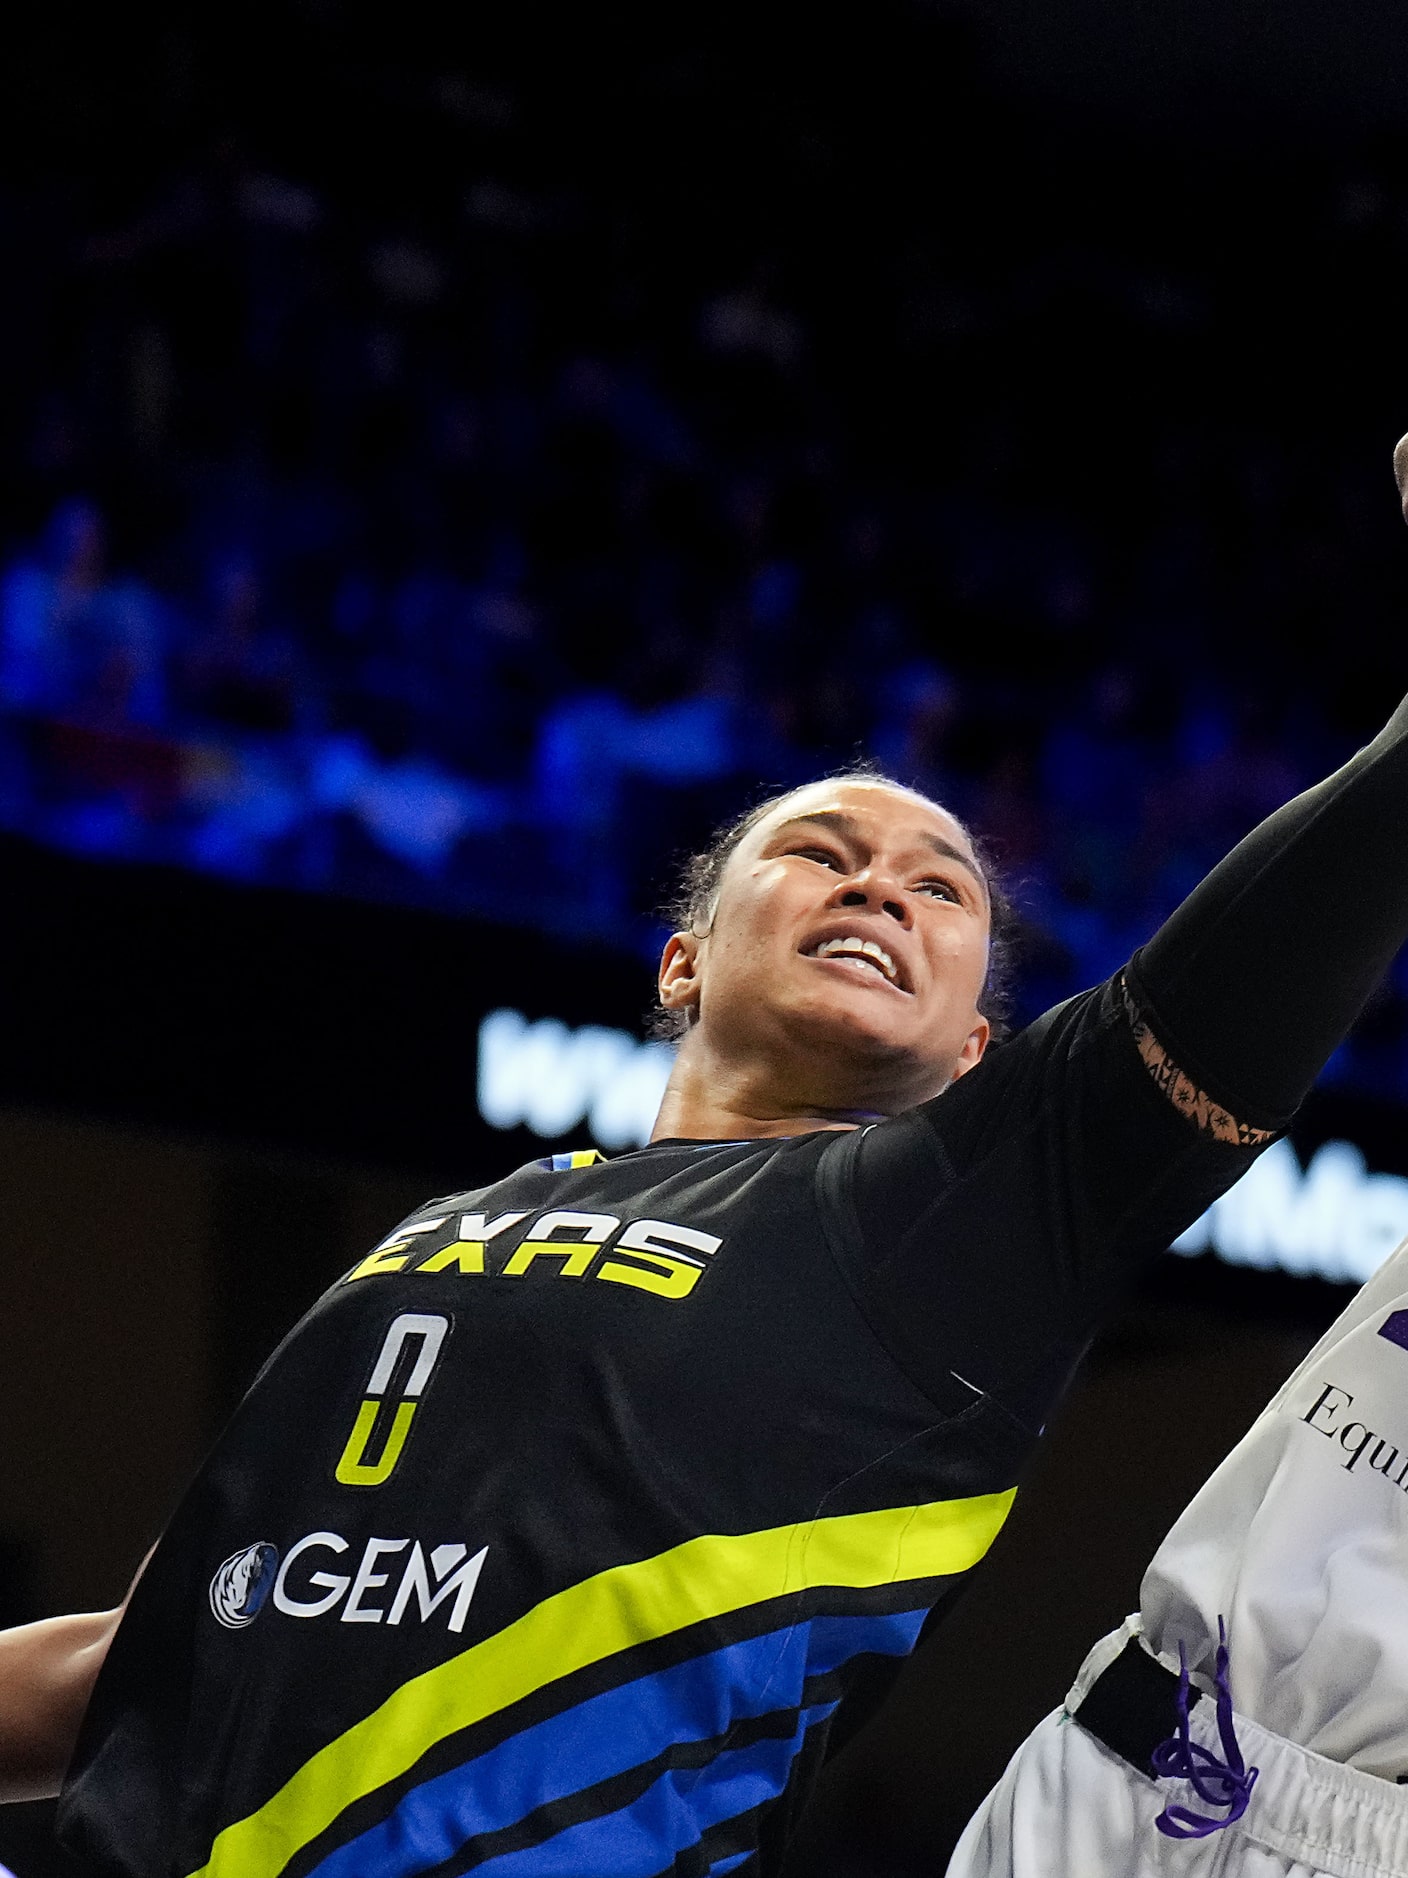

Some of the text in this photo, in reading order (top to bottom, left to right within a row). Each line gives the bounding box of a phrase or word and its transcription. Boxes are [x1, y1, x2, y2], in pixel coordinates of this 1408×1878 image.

[347, 1208, 723, 1299] EXAS
[335, 1313, 449, 1486] 0
[274, 1532, 489, 1632] GEM
